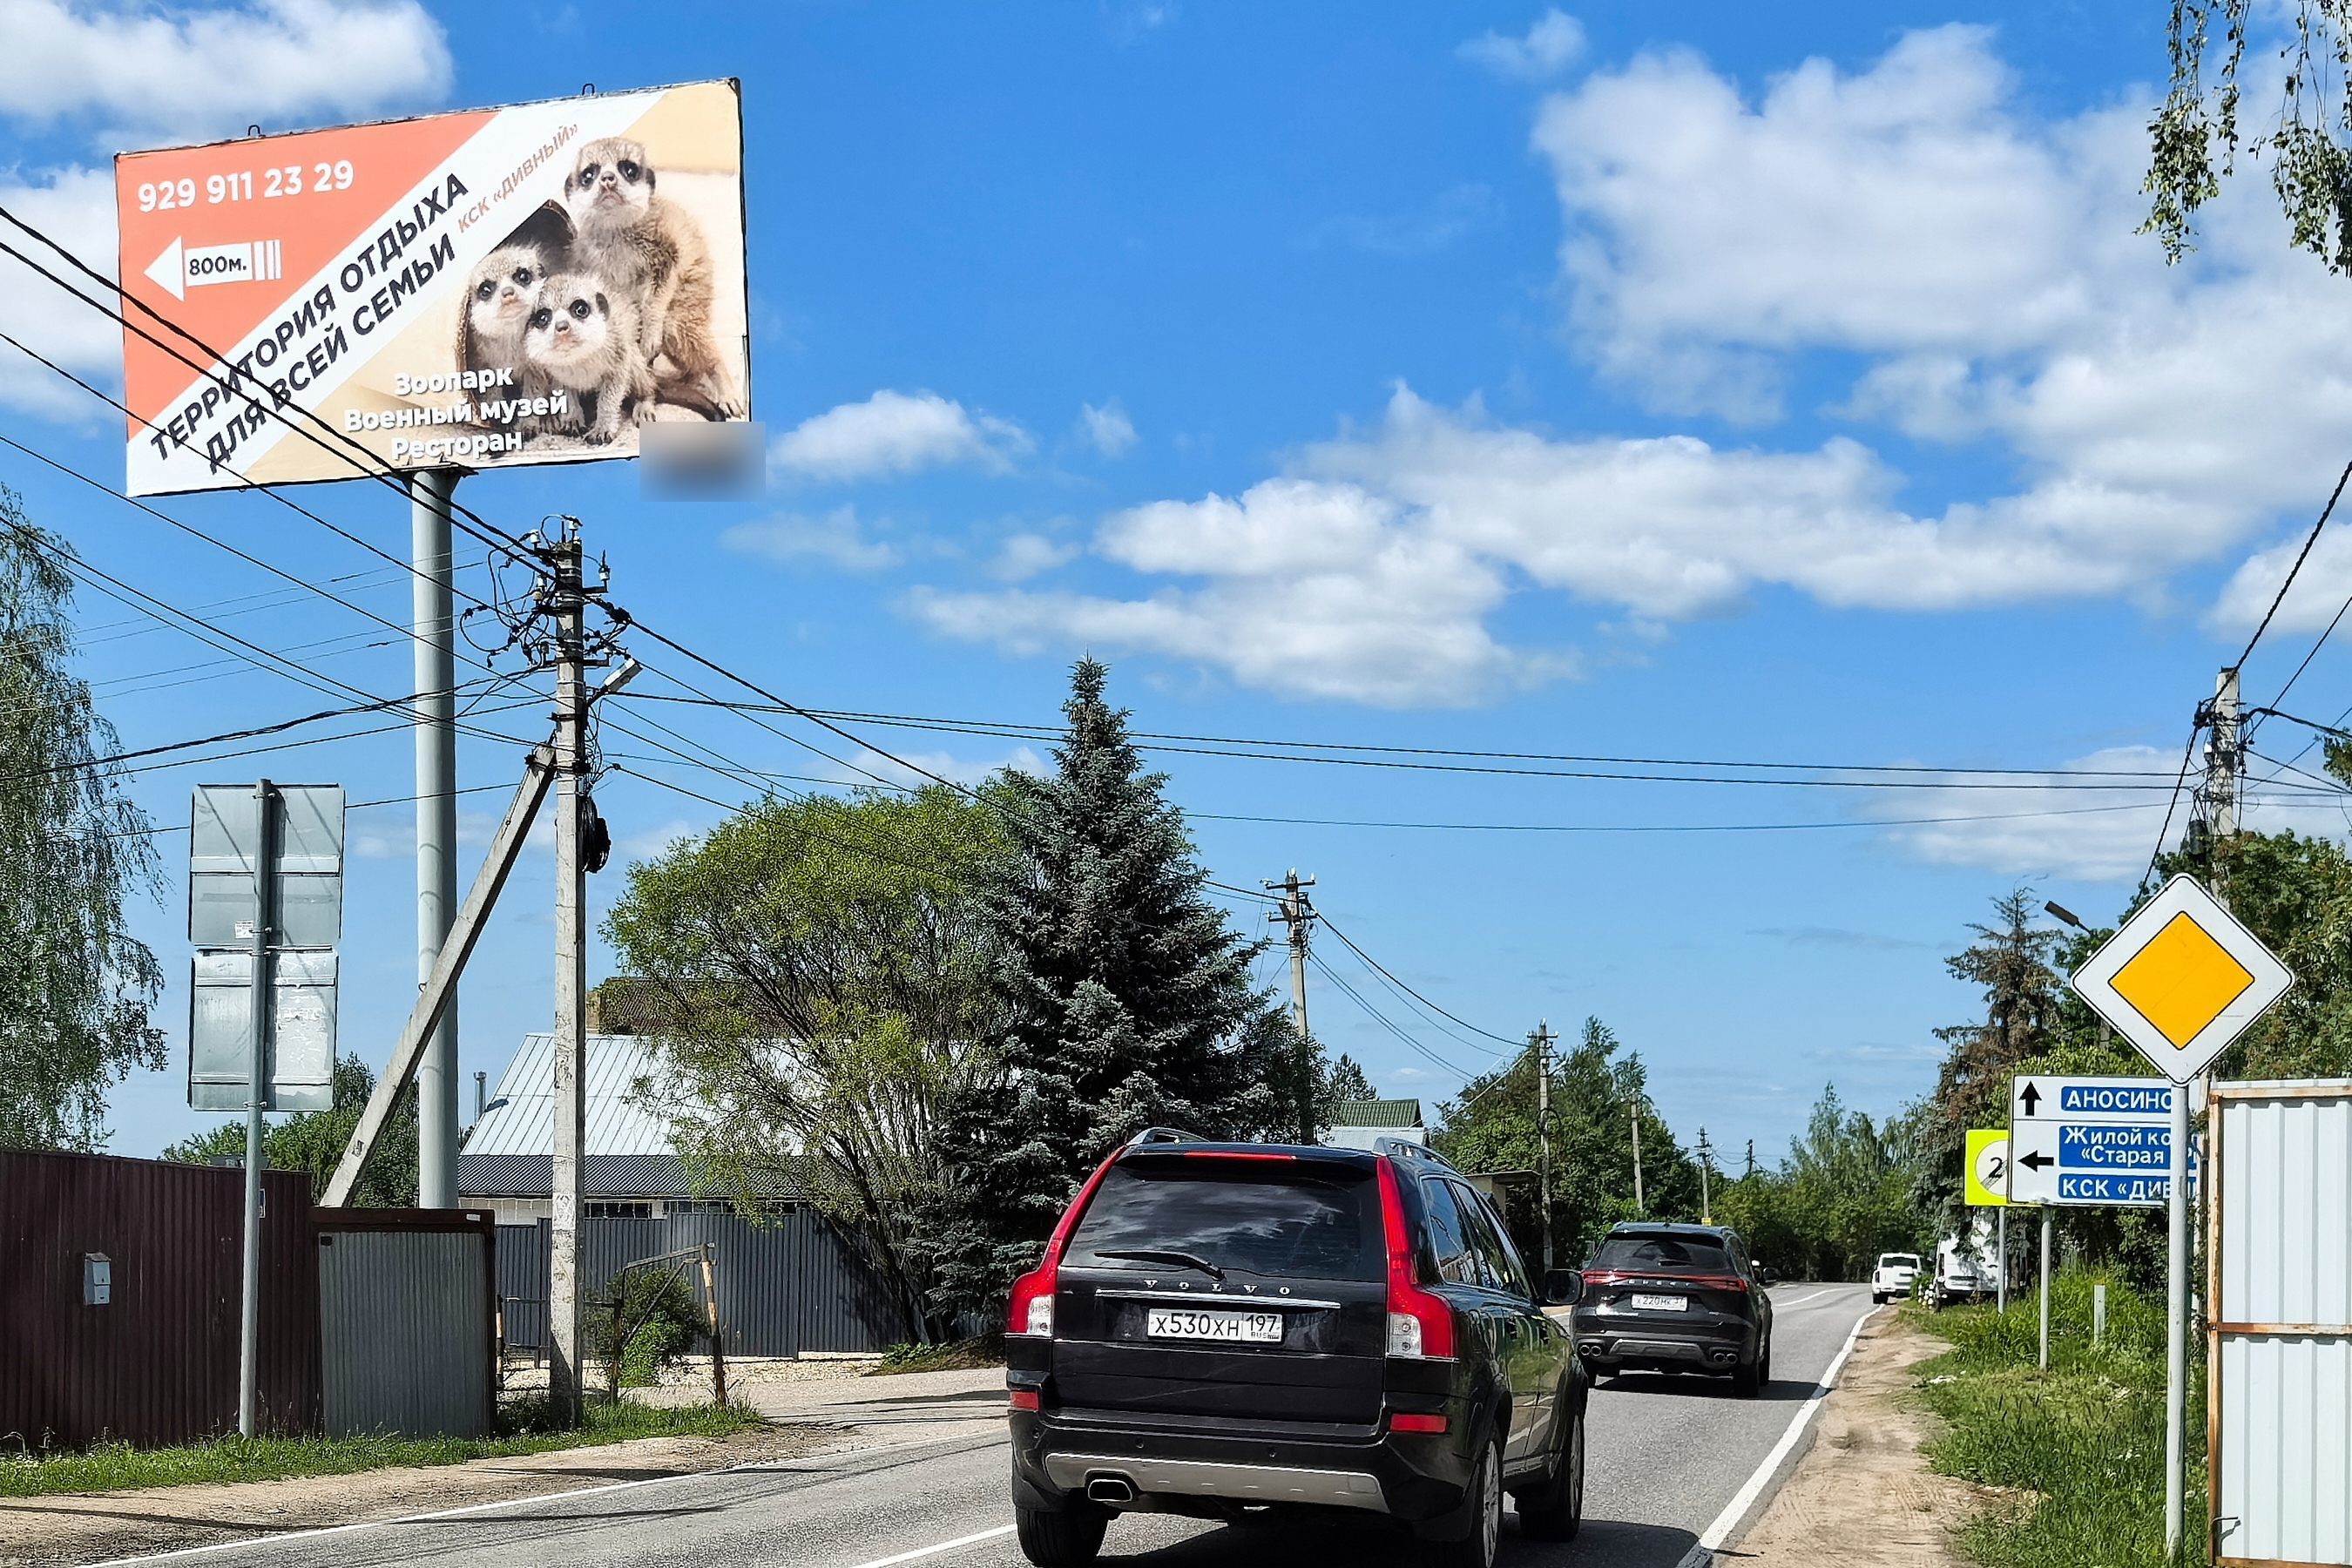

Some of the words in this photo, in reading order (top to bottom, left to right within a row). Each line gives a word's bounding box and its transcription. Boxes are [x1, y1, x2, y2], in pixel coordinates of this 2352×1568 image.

[138, 178, 196, 213] 929
[206, 171, 253, 204] 911
[264, 166, 302, 198] 23
[314, 159, 355, 193] 29
[457, 196, 490, 233] КСК
[492, 123, 578, 203] «ДИВНЫЙ»
[150, 283, 337, 461] ТЕРРИТОРИЯ
[340, 172, 470, 293] ОТДЫХА
[206, 397, 267, 476] ДЛЯ
[268, 321, 349, 413] ВСЕЙ
[352, 232, 456, 336] СЕМЬИ
[394, 367, 514, 395] Зоопарк
[343, 397, 473, 433] Военный
[479, 389, 569, 425] музей
[391, 430, 524, 461] Ресторан
[2064, 1126, 2142, 1146] Жилой
[1990, 1157, 2004, 1179] 2
[2081, 1145, 2165, 1167] «Старая
[2062, 1178, 2110, 1198] КСК
[1143, 1278, 1291, 1295] VOLVO
[1245, 1314, 1278, 1333] 197
